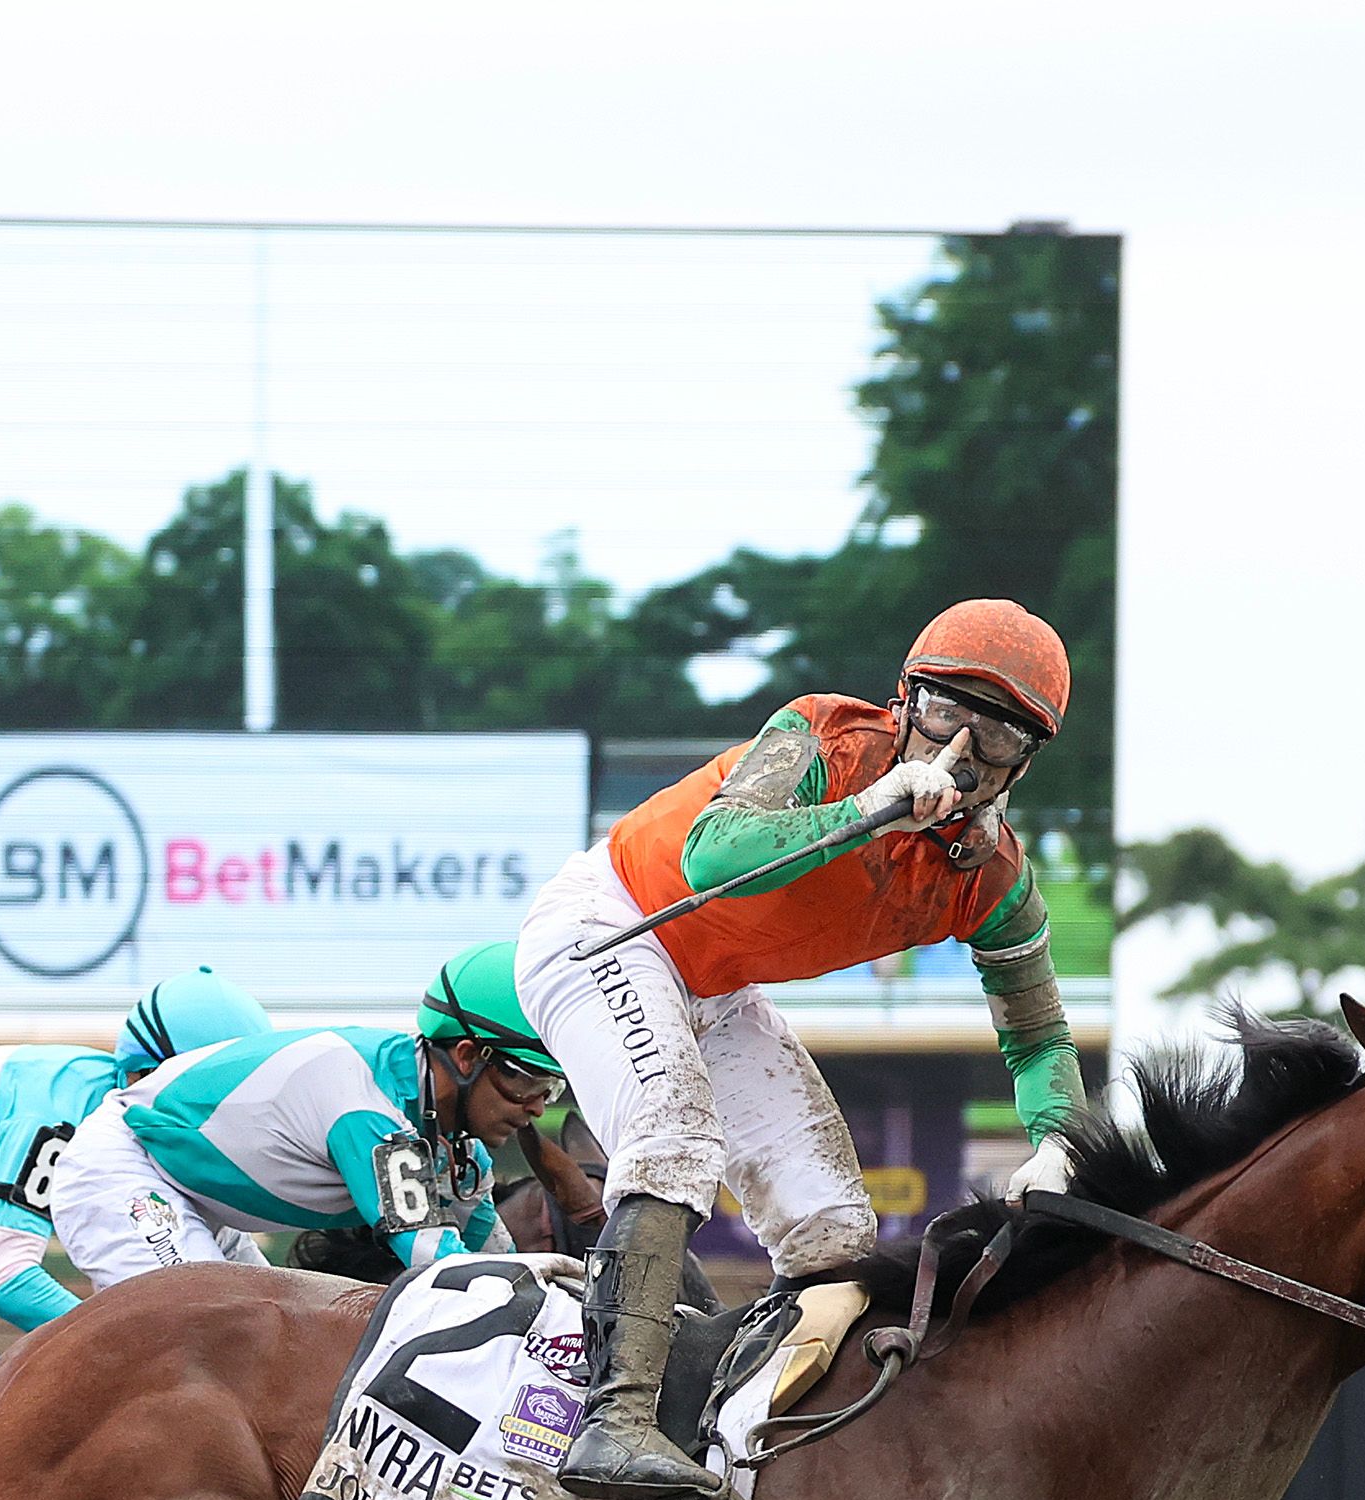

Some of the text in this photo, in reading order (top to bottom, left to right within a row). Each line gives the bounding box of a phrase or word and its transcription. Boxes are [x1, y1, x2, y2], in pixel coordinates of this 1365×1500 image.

[164, 838, 529, 904] BetMakers
[589, 955, 667, 1087] RISPOLI
[23, 1136, 69, 1210] 8
[387, 1149, 431, 1224] 6
[362, 1260, 548, 1456] 2
[503, 1418, 569, 1449] CHALLENG
[513, 1434, 556, 1456] SERIES
